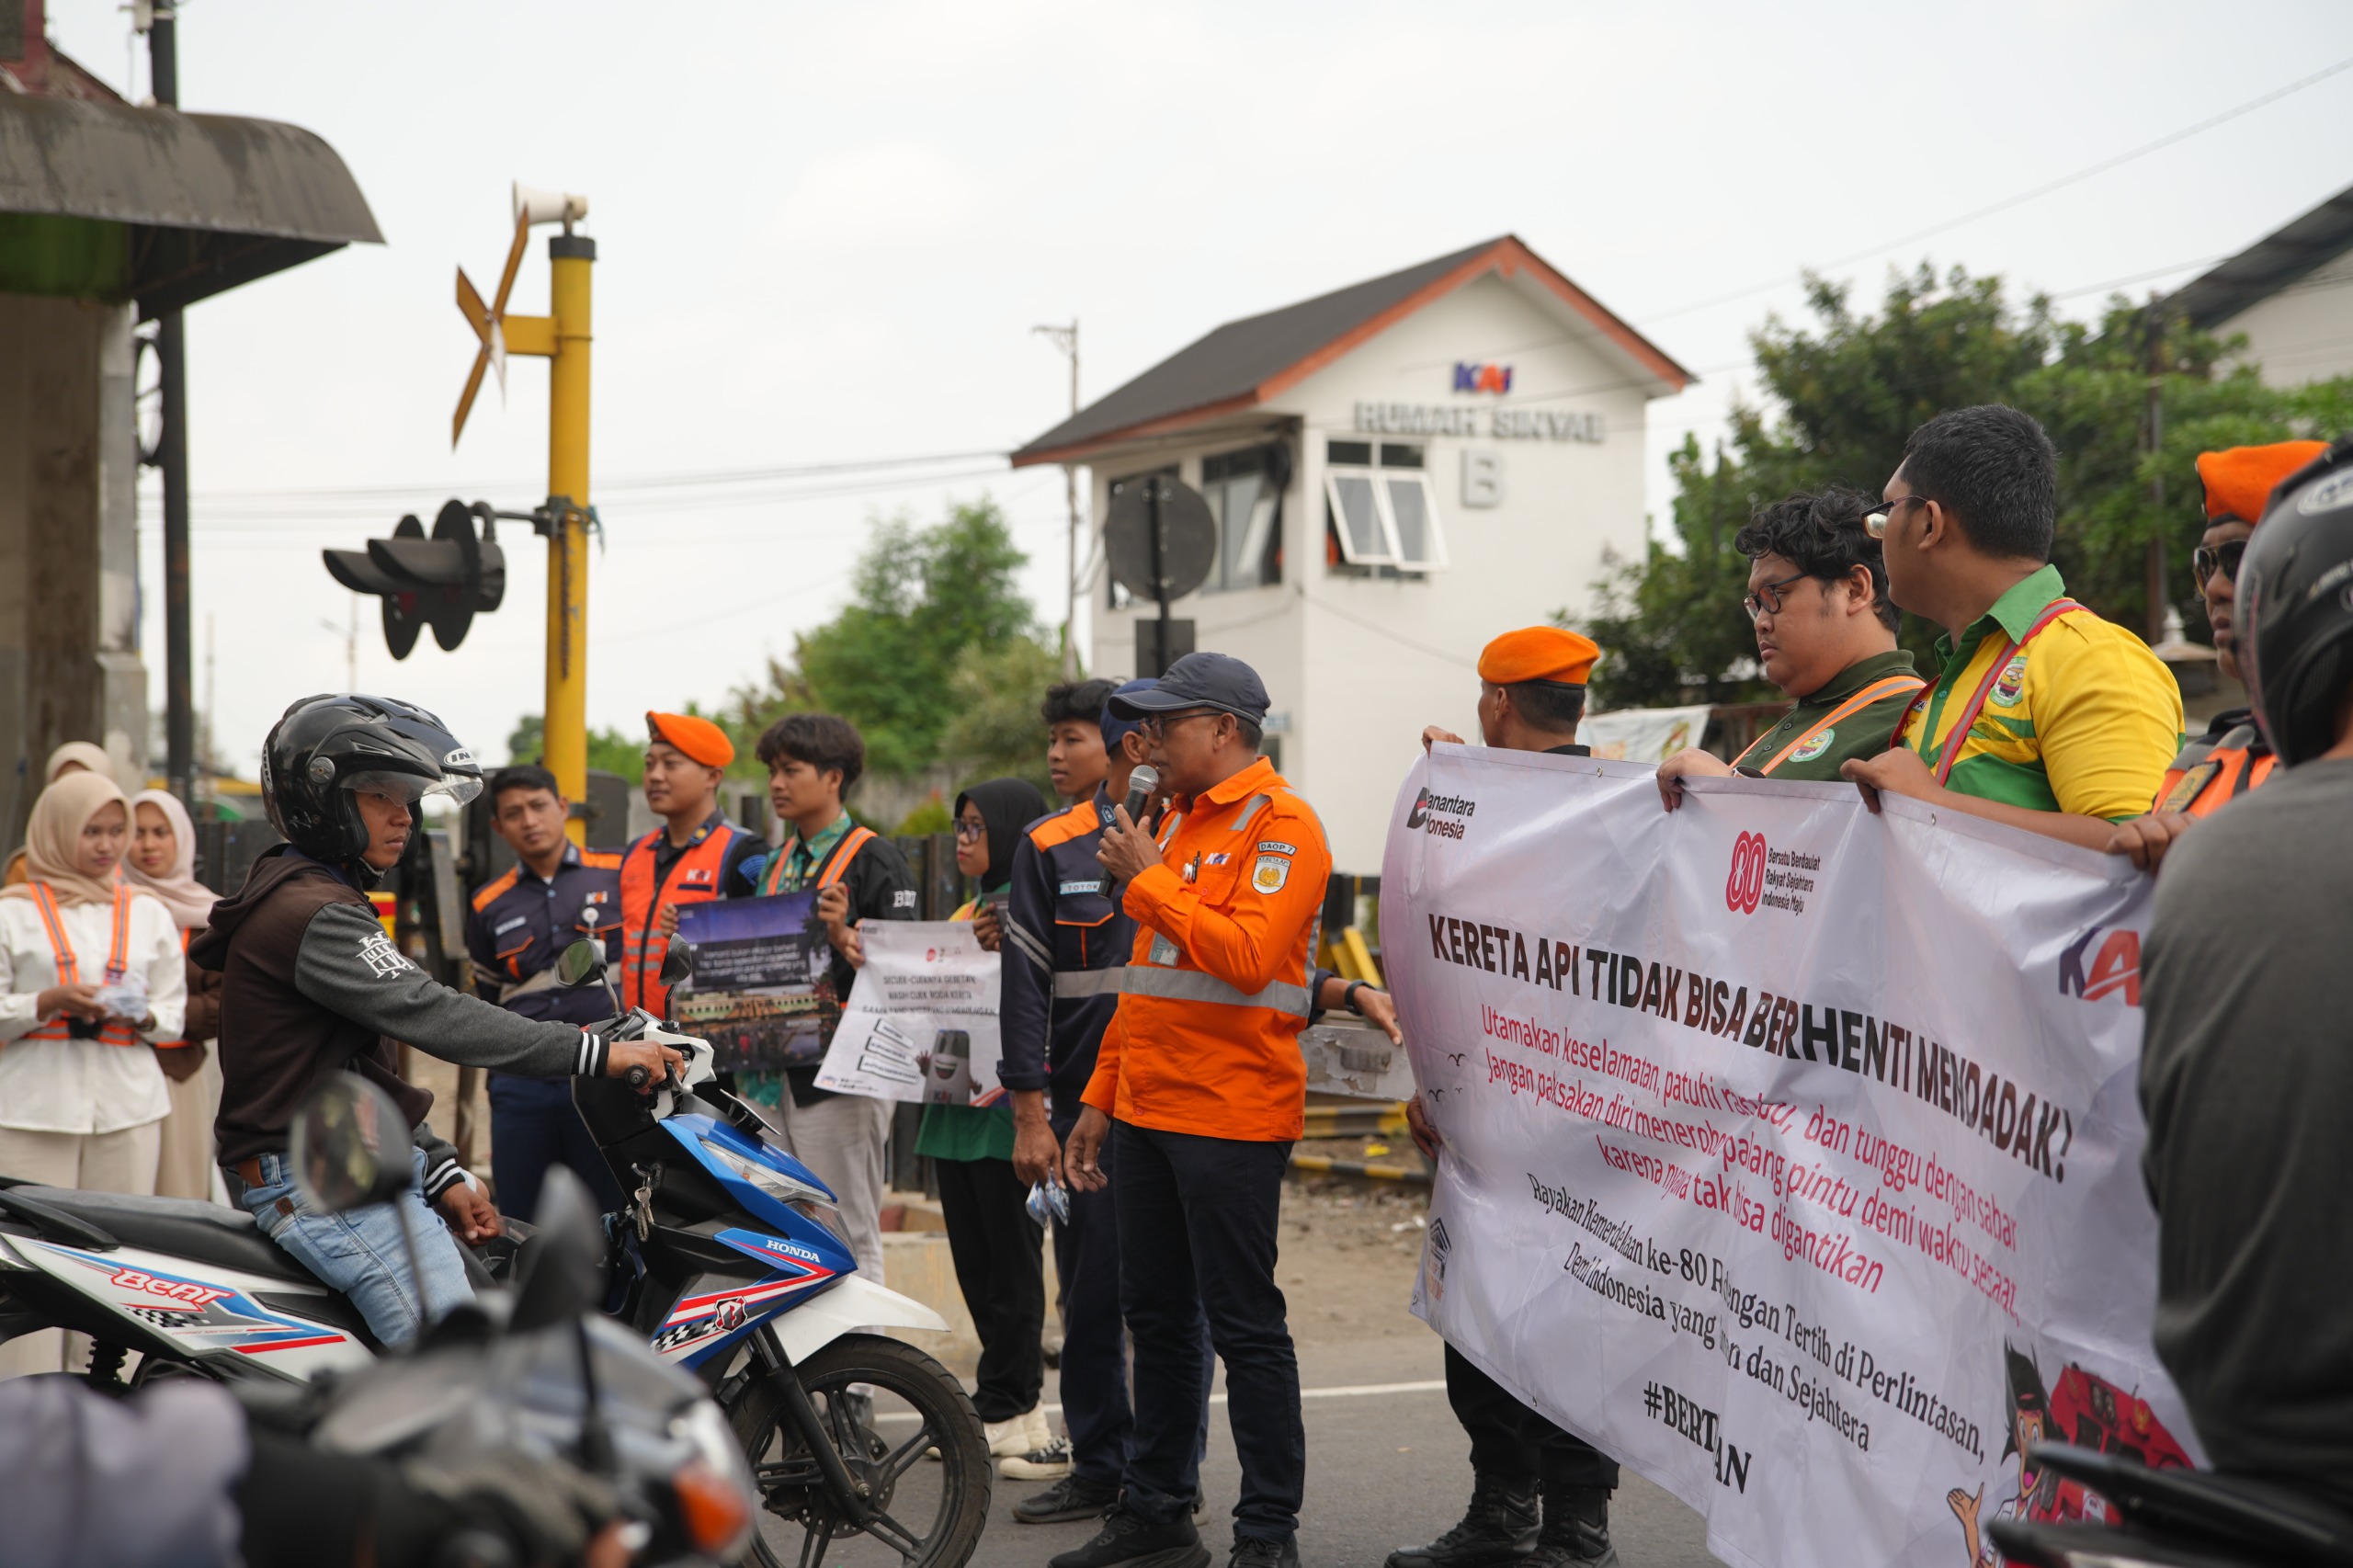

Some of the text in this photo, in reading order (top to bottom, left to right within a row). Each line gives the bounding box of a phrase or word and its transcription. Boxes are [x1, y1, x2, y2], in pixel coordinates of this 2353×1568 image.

[1461, 449, 1506, 508] B
[451, 752, 471, 763] IN
[1260, 843, 1286, 851] DAOP
[1725, 830, 1767, 915] 80
[1765, 869, 1814, 893] Rakyat Sejahtera
[1768, 847, 1821, 871] Bersatu Berdaulat
[1761, 890, 1804, 916] Indonesia Maju
[2059, 926, 2142, 1007] KA
[1428, 914, 2072, 1184] KERETA API TIDAK BISA BERHENTI MENDADAK!
[1482, 1004, 1559, 1058] Utamakan
[1562, 1026, 1660, 1100] keselamatan,
[1663, 1071, 1722, 1111] patuhi
[1803, 1104, 1850, 1154] dan
[1853, 1123, 1922, 1193] tunggu
[1925, 1151, 1975, 1224] dengan
[1977, 1193, 2018, 1252] sabar
[1485, 1047, 1534, 1096] Jangan
[1536, 1069, 1604, 1122] paksakan
[1604, 1093, 1634, 1133] diri
[1723, 1131, 1785, 1197] palang
[1786, 1162, 1859, 1218] pintu
[1861, 1187, 1915, 1245] demi
[1918, 1223, 1971, 1279] waktu
[766, 1239, 821, 1264] HONDA
[1596, 1133, 1664, 1185] karena
[1694, 1172, 1732, 1214] tak
[1733, 1179, 1766, 1233] bisa
[1771, 1203, 1883, 1293] digantikan
[1527, 1172, 1584, 1227] Rayakan
[1647, 1237, 1708, 1288] ke-80
[1785, 1303, 1832, 1369] Tertib
[1834, 1342, 1855, 1381] di
[1857, 1350, 1985, 1466] Perlintasan,
[1586, 1259, 1666, 1321] Indonesia
[1669, 1300, 1717, 1350] yang
[1746, 1345, 1784, 1392] dan
[1787, 1366, 1870, 1452] Sejahtera
